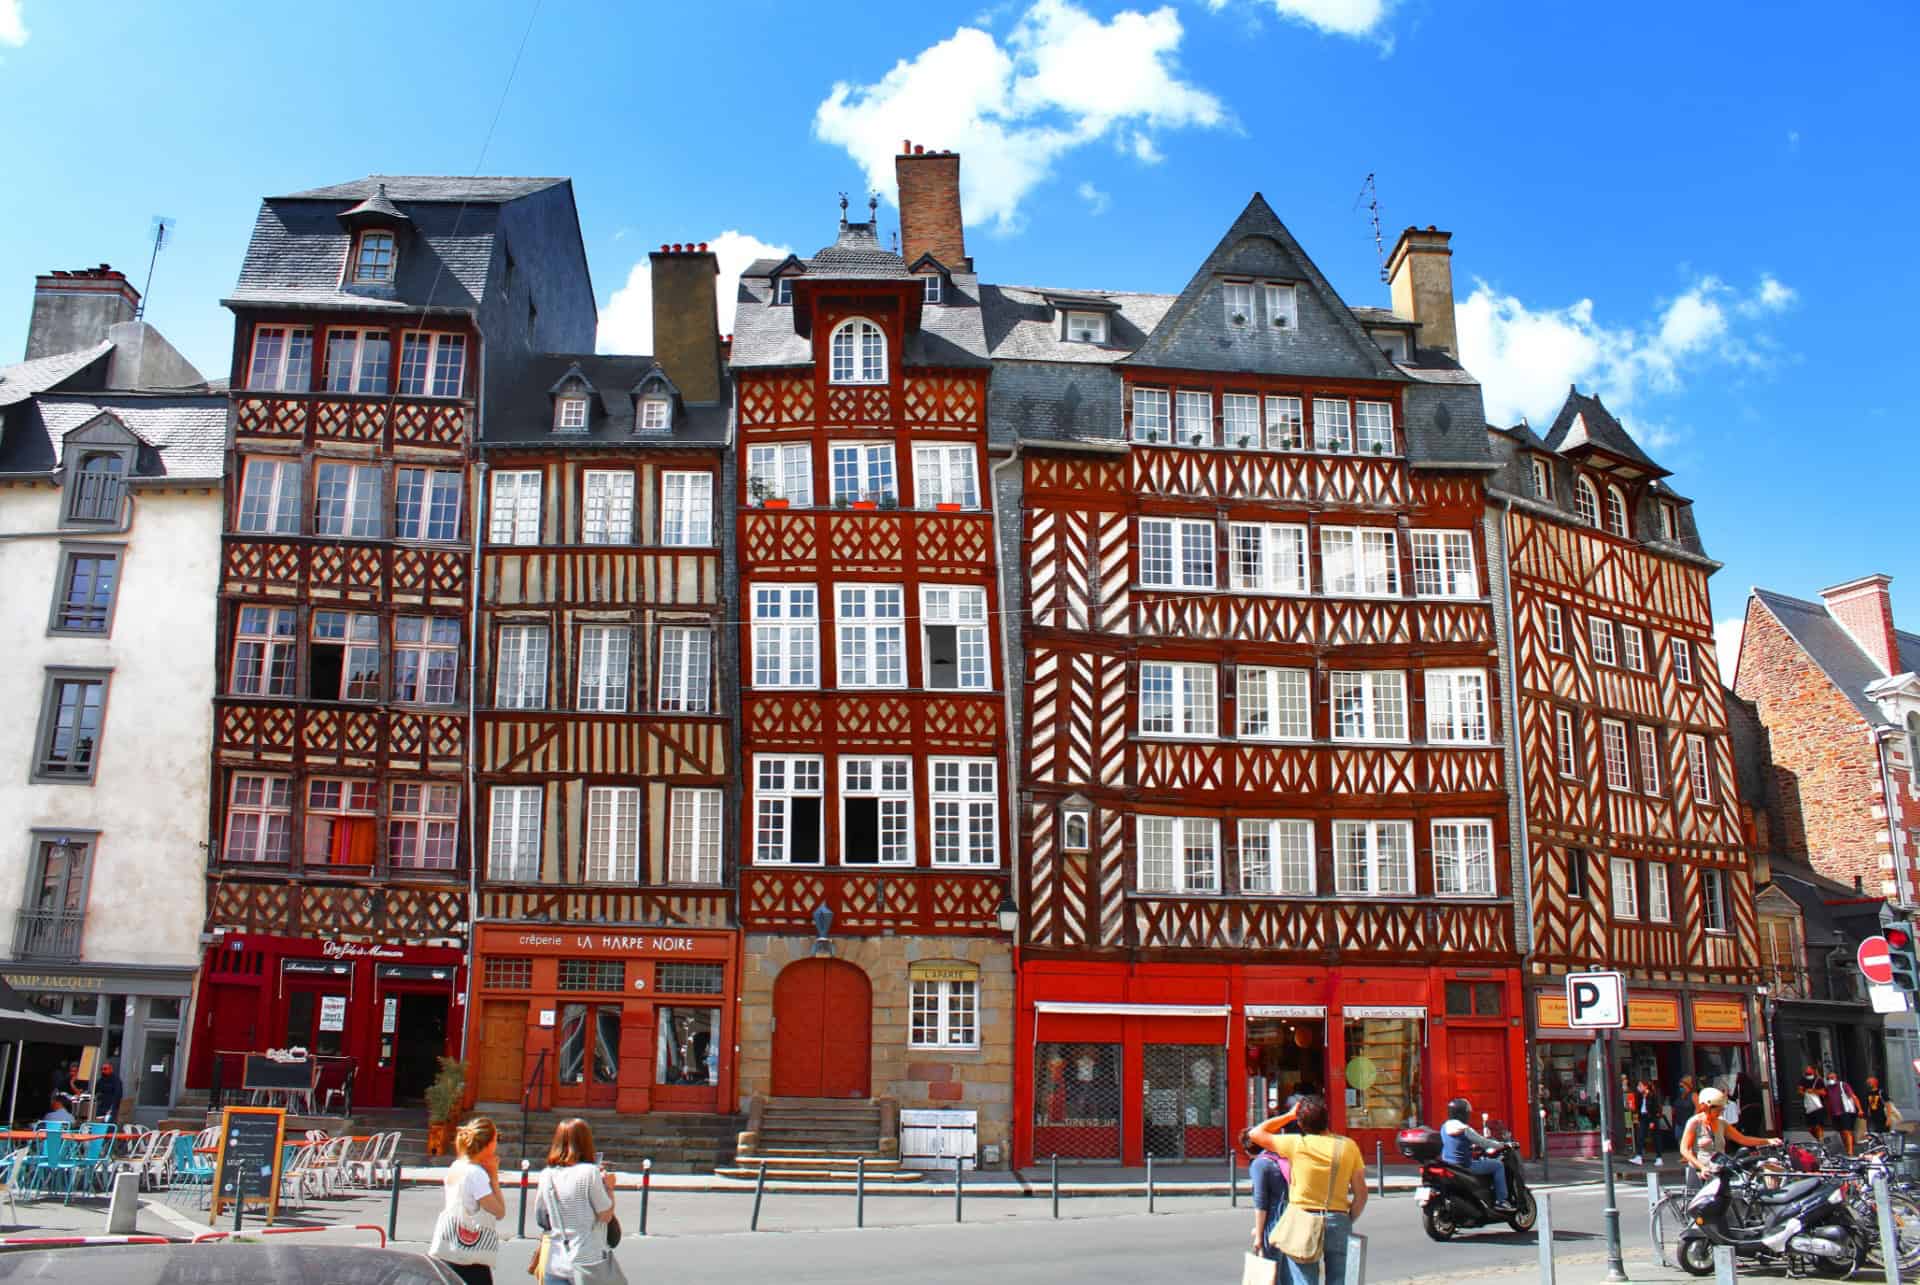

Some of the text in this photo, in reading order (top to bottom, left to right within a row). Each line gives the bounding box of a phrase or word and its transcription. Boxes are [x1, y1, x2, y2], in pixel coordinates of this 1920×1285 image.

[519, 935, 694, 951] crêperie LA HARPE NOIRE
[6, 975, 40, 986] AMP
[1572, 981, 1600, 1020] P
